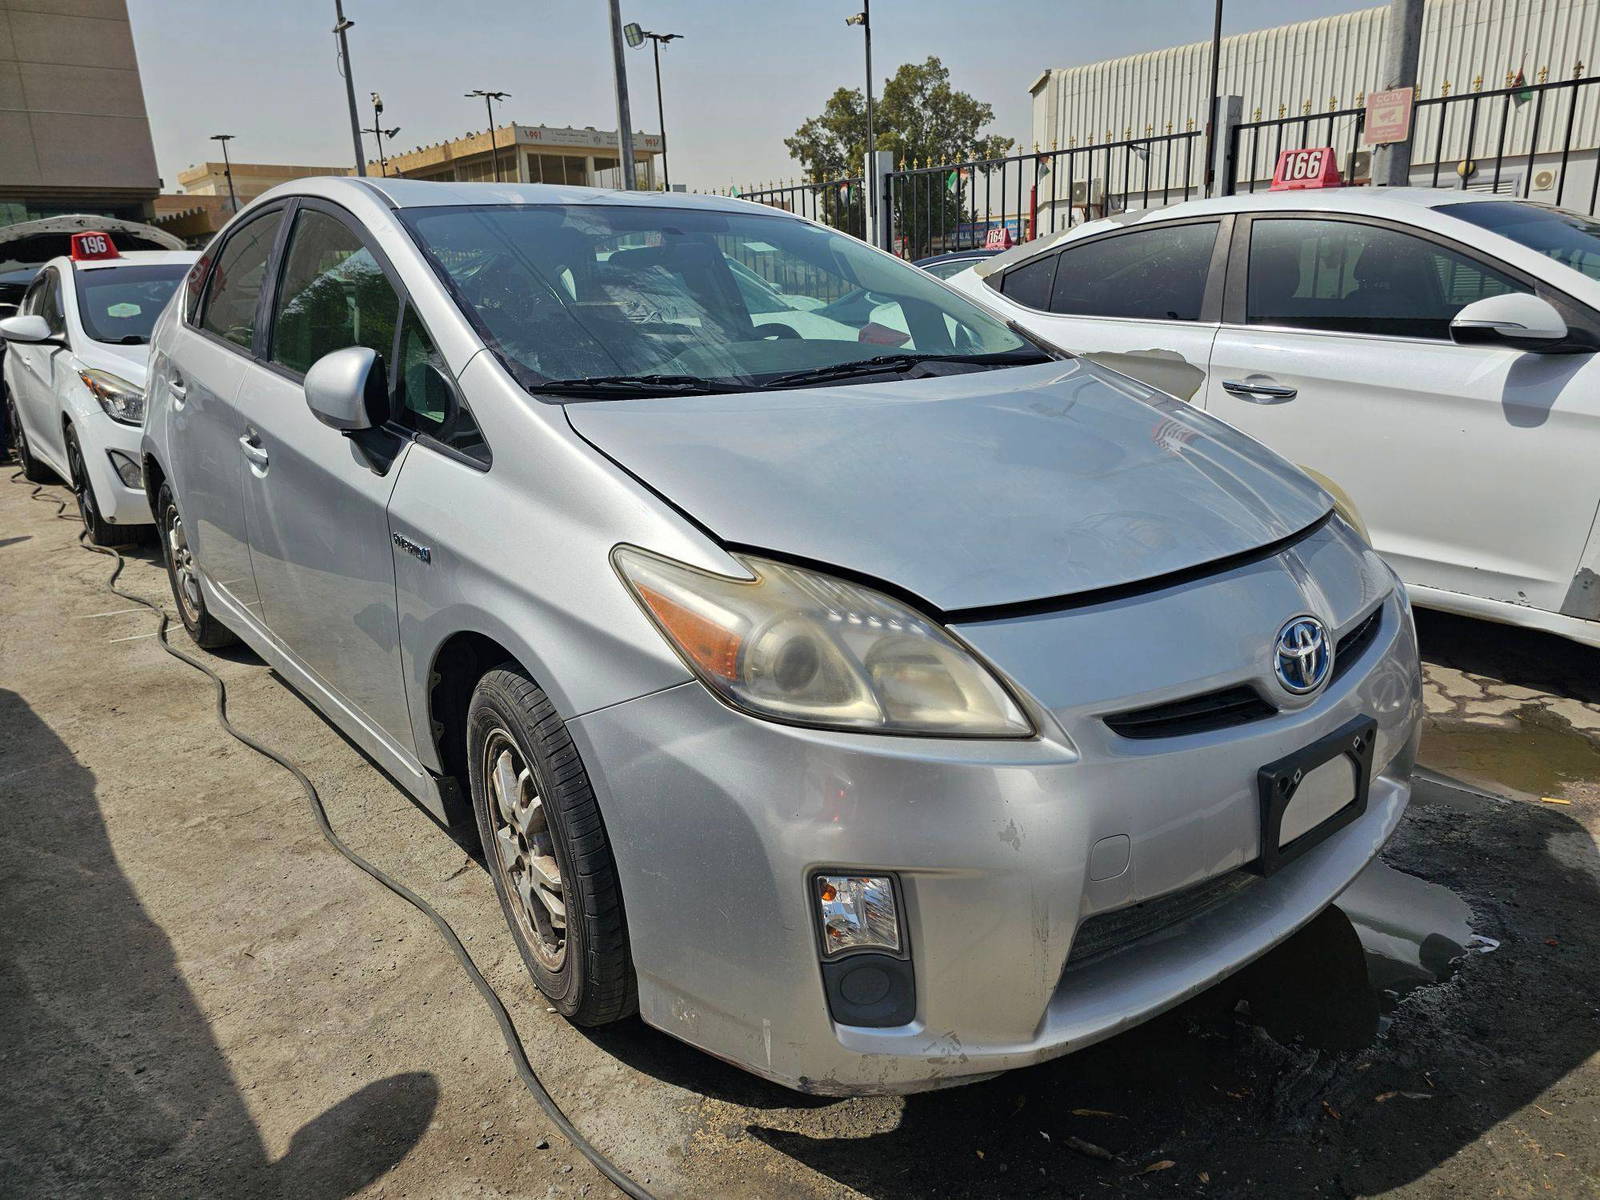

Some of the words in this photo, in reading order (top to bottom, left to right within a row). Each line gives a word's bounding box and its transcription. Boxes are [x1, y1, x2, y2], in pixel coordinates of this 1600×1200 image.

[1285, 151, 1322, 181] 166
[80, 235, 108, 255] 196
[989, 230, 1003, 244] 164
